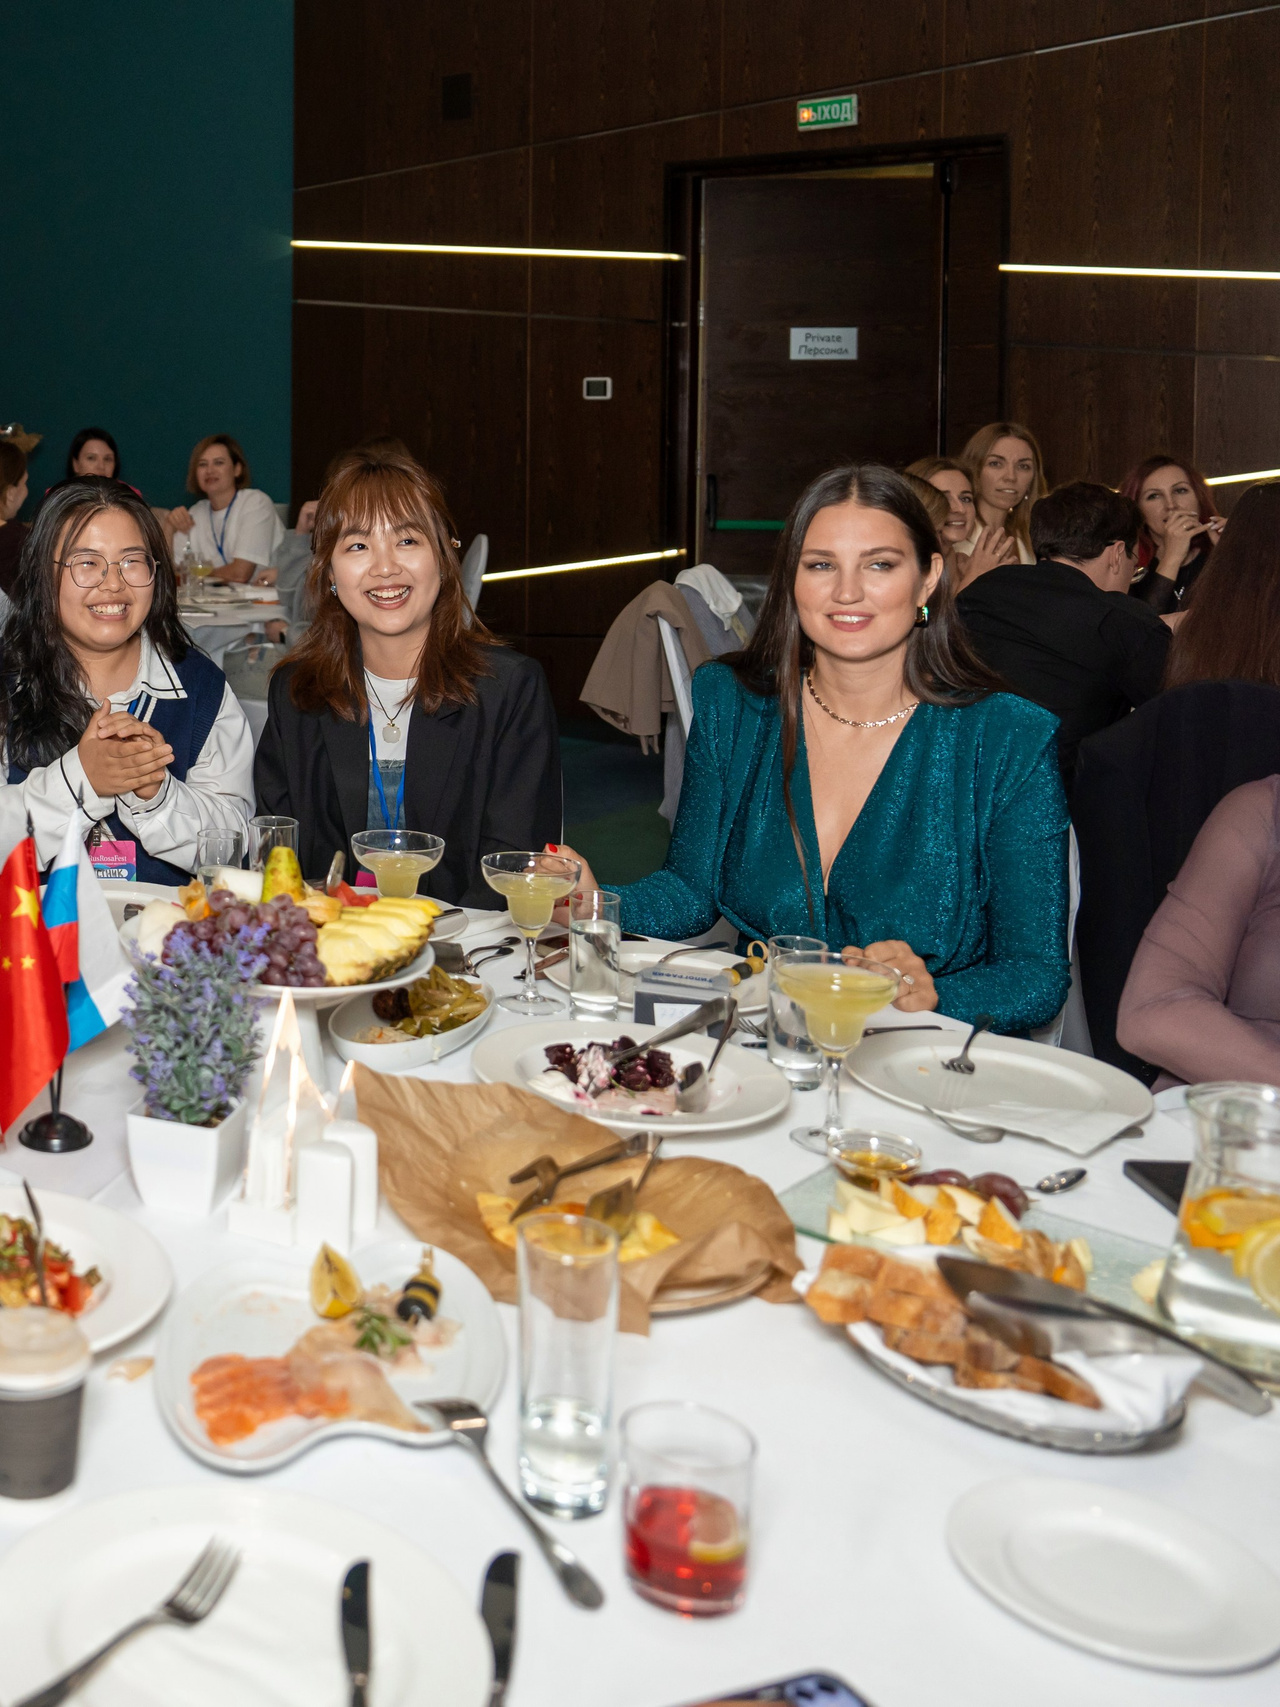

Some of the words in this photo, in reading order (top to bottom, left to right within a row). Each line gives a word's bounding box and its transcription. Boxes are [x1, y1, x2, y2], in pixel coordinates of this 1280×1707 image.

[800, 102, 851, 123] ВЫХОД
[804, 332, 842, 343] Private
[798, 344, 849, 357] Персонал
[94, 868, 124, 878] СТНИК
